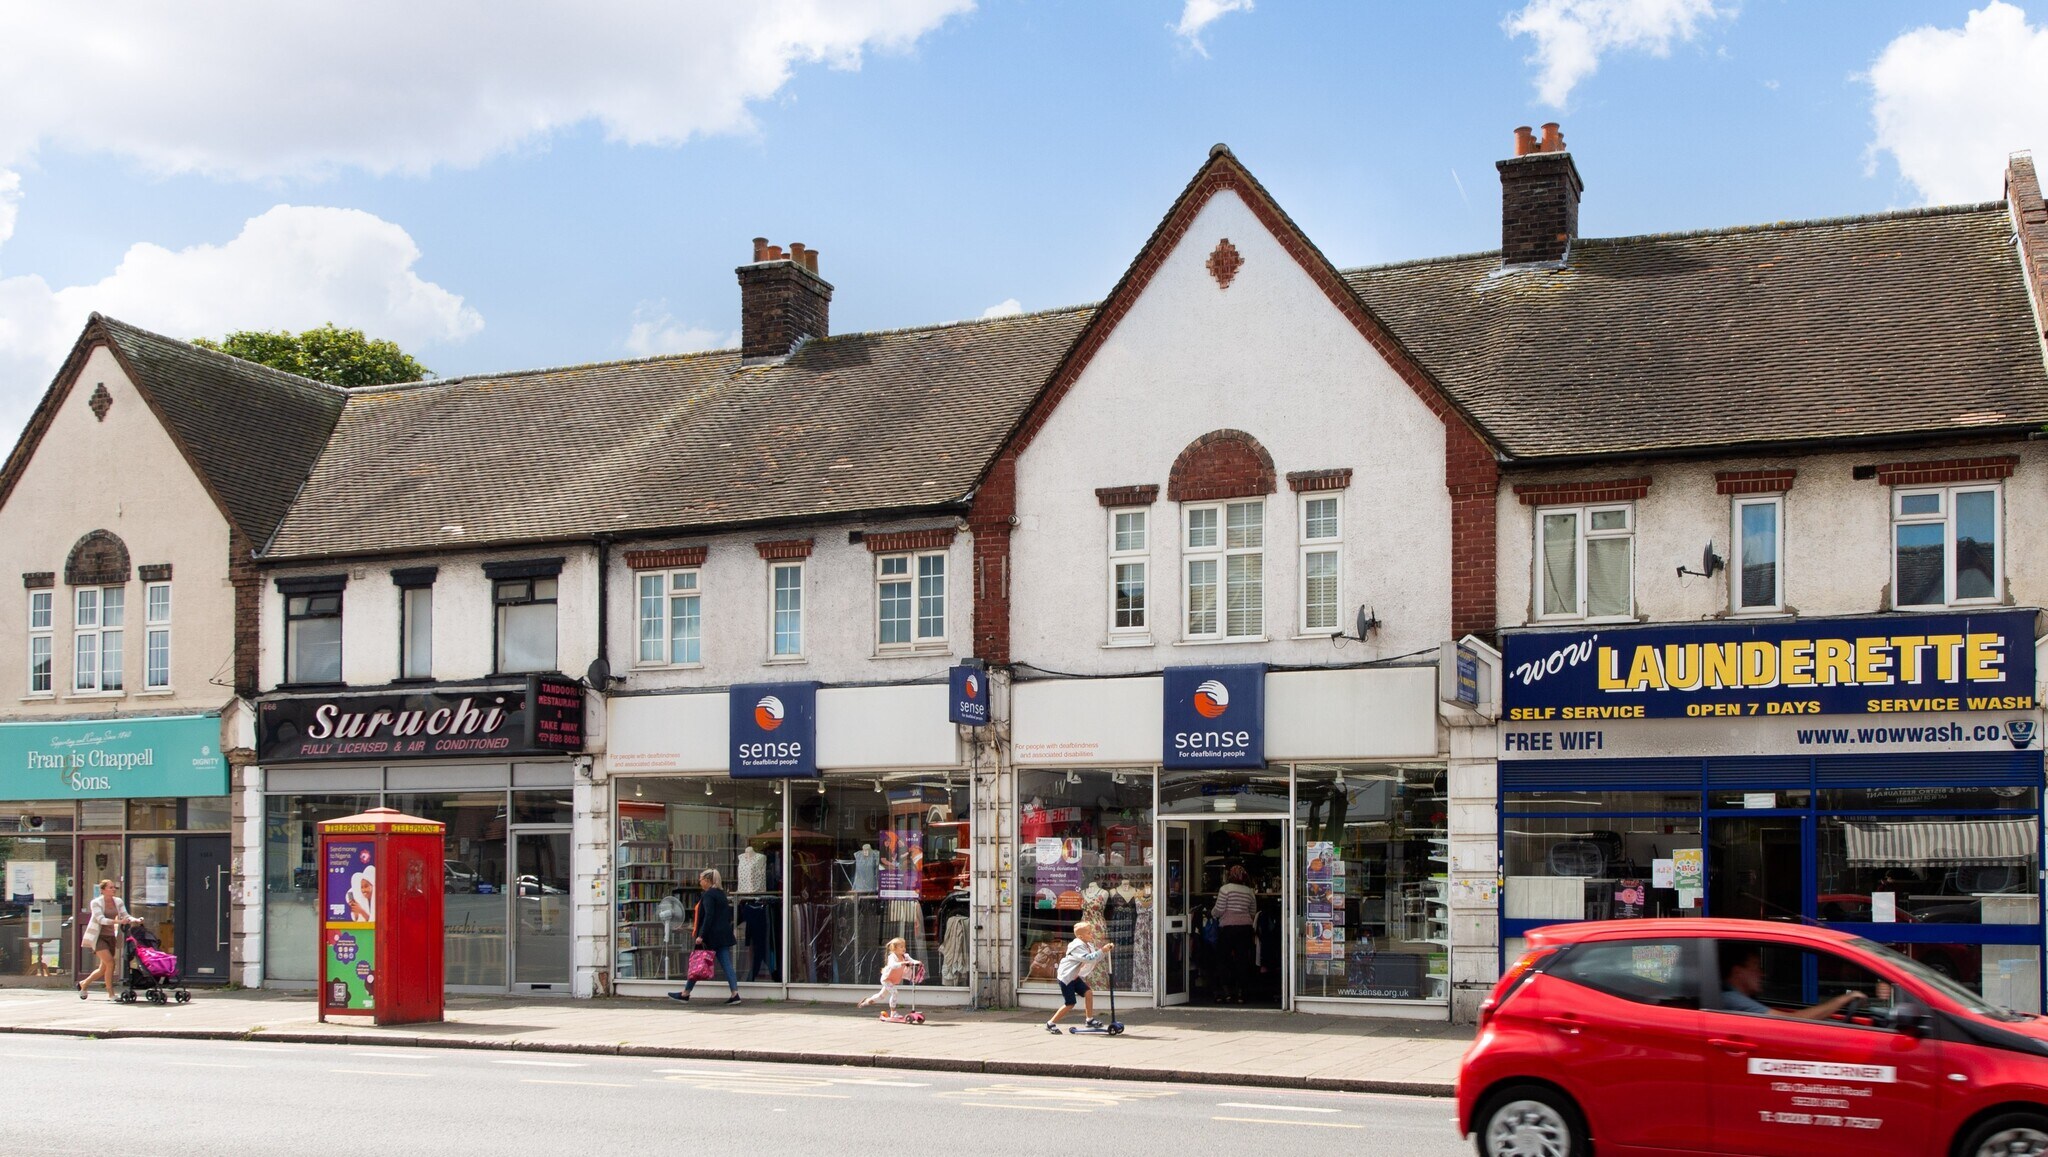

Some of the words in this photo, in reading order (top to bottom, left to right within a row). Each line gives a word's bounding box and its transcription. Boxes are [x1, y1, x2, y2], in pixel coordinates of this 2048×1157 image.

[1598, 633, 2006, 693] LAUNDERETTE
[542, 683, 577, 696] TANDOORI
[538, 695, 581, 708] RESTAURANT
[960, 701, 984, 715] sense
[1686, 703, 1741, 716] OPEN
[1747, 703, 1757, 715] 7
[1767, 701, 1821, 714] DAYS
[1867, 697, 1959, 713] SERVICE
[1967, 696, 2032, 711] WASH
[308, 696, 506, 739] Suruchi
[557, 710, 563, 719] &
[1510, 707, 1556, 720] SELF
[1561, 705, 1645, 719] SERVICE
[540, 720, 558, 730] TAKE
[560, 722, 578, 732] AWAY
[300, 743, 332, 755] FULLY
[337, 741, 388, 753] LICENSED
[393, 741, 402, 752] &
[407, 740, 425, 752] AIR
[435, 737, 509, 751] CONDITIONED
[1174, 729, 1250, 749] sense
[1505, 731, 1552, 751] FREE
[1559, 730, 1603, 750] WIFI
[738, 739, 802, 759] sense
[1178, 750, 1190, 758] For
[1190, 750, 1222, 758] deafblind
[1222, 750, 1246, 759] people
[88, 748, 153, 771] Chappell
[192, 758, 220, 766] DIGNITY
[742, 758, 752, 766] For
[752, 758, 779, 766] deafblind
[779, 758, 799, 767] people
[71, 771, 112, 791] Sons.
[328, 824, 373, 833] TELEPHONE
[394, 824, 437, 833] TELEPHONE
[330, 860, 350, 868] instantly
[1037, 865, 1056, 873] Clothing
[1056, 864, 1079, 872] donations
[1337, 988, 1410, 999] www.sense.org.uk
[1758, 1061, 1817, 1075] CARPET
[1819, 1065, 1884, 1079] CORNER
